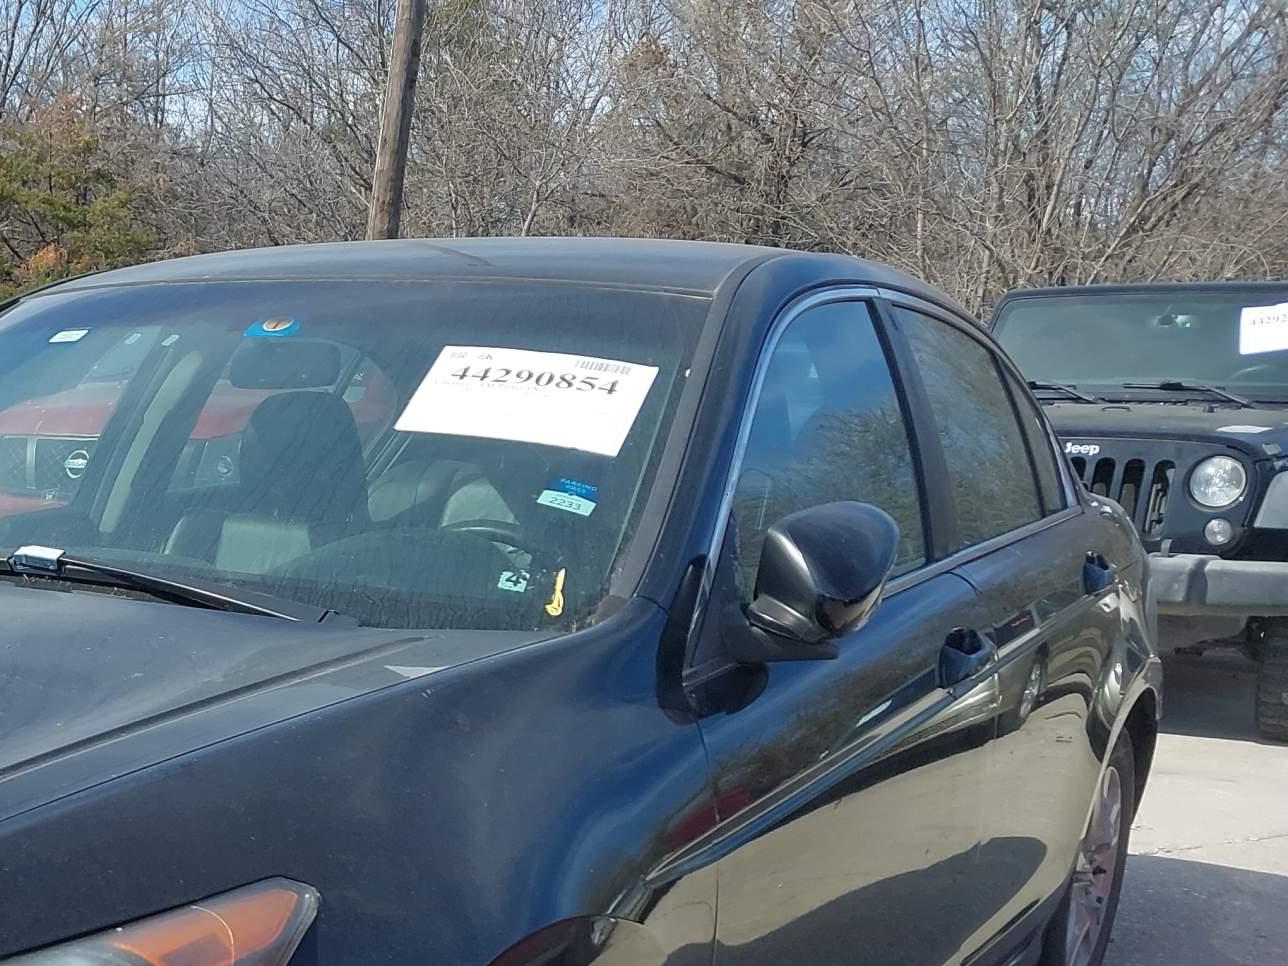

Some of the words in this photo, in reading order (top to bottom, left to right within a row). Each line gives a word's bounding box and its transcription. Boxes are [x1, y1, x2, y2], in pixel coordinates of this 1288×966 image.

[450, 365, 620, 395] 44290854
[1064, 442, 1100, 456] Jeep
[549, 496, 582, 511] 2233
